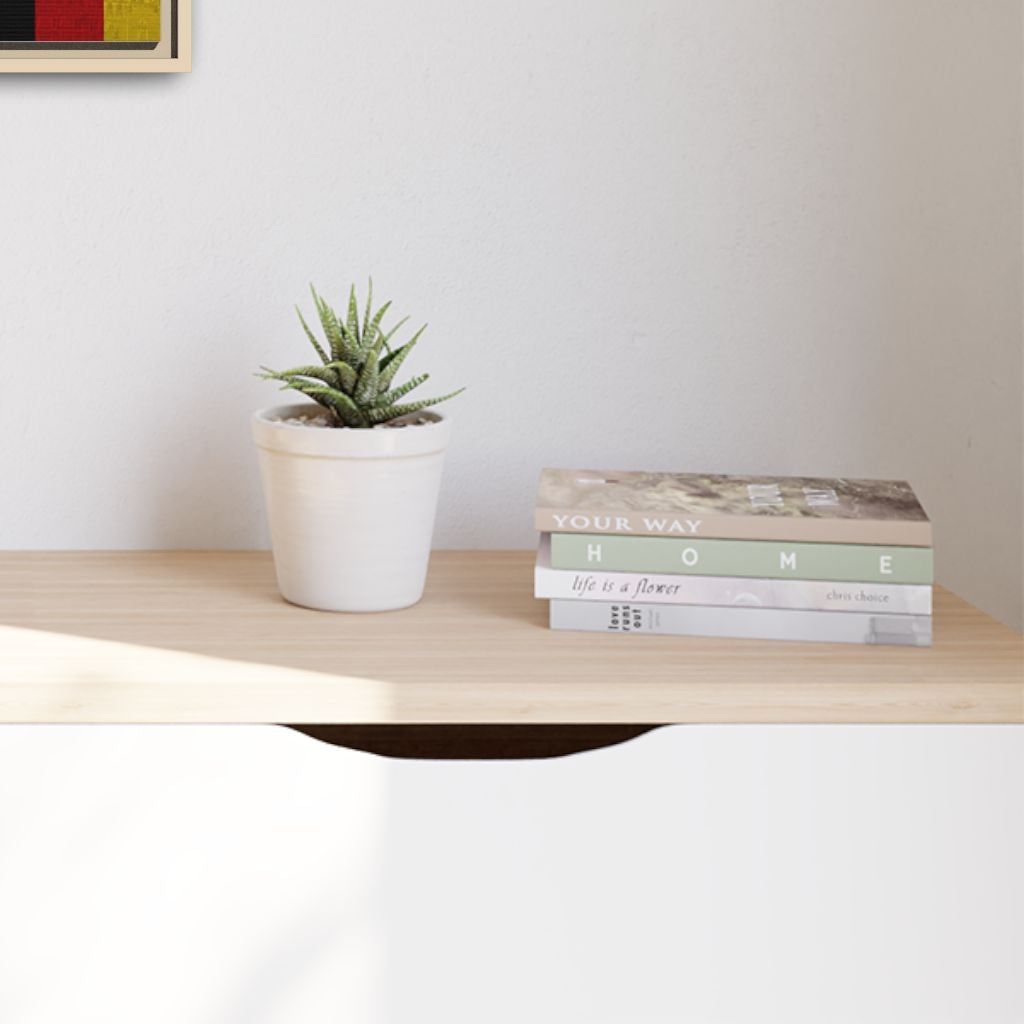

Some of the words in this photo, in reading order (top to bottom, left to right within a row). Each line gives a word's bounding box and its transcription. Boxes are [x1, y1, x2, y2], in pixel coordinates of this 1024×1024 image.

[552, 515, 633, 531] YOUR
[643, 518, 703, 534] WAY
[572, 576, 596, 597] life
[602, 578, 615, 593] is
[620, 583, 630, 593] a
[632, 578, 682, 599] flower
[607, 605, 619, 629] love
[622, 605, 630, 631] runs
[631, 609, 641, 628] out
